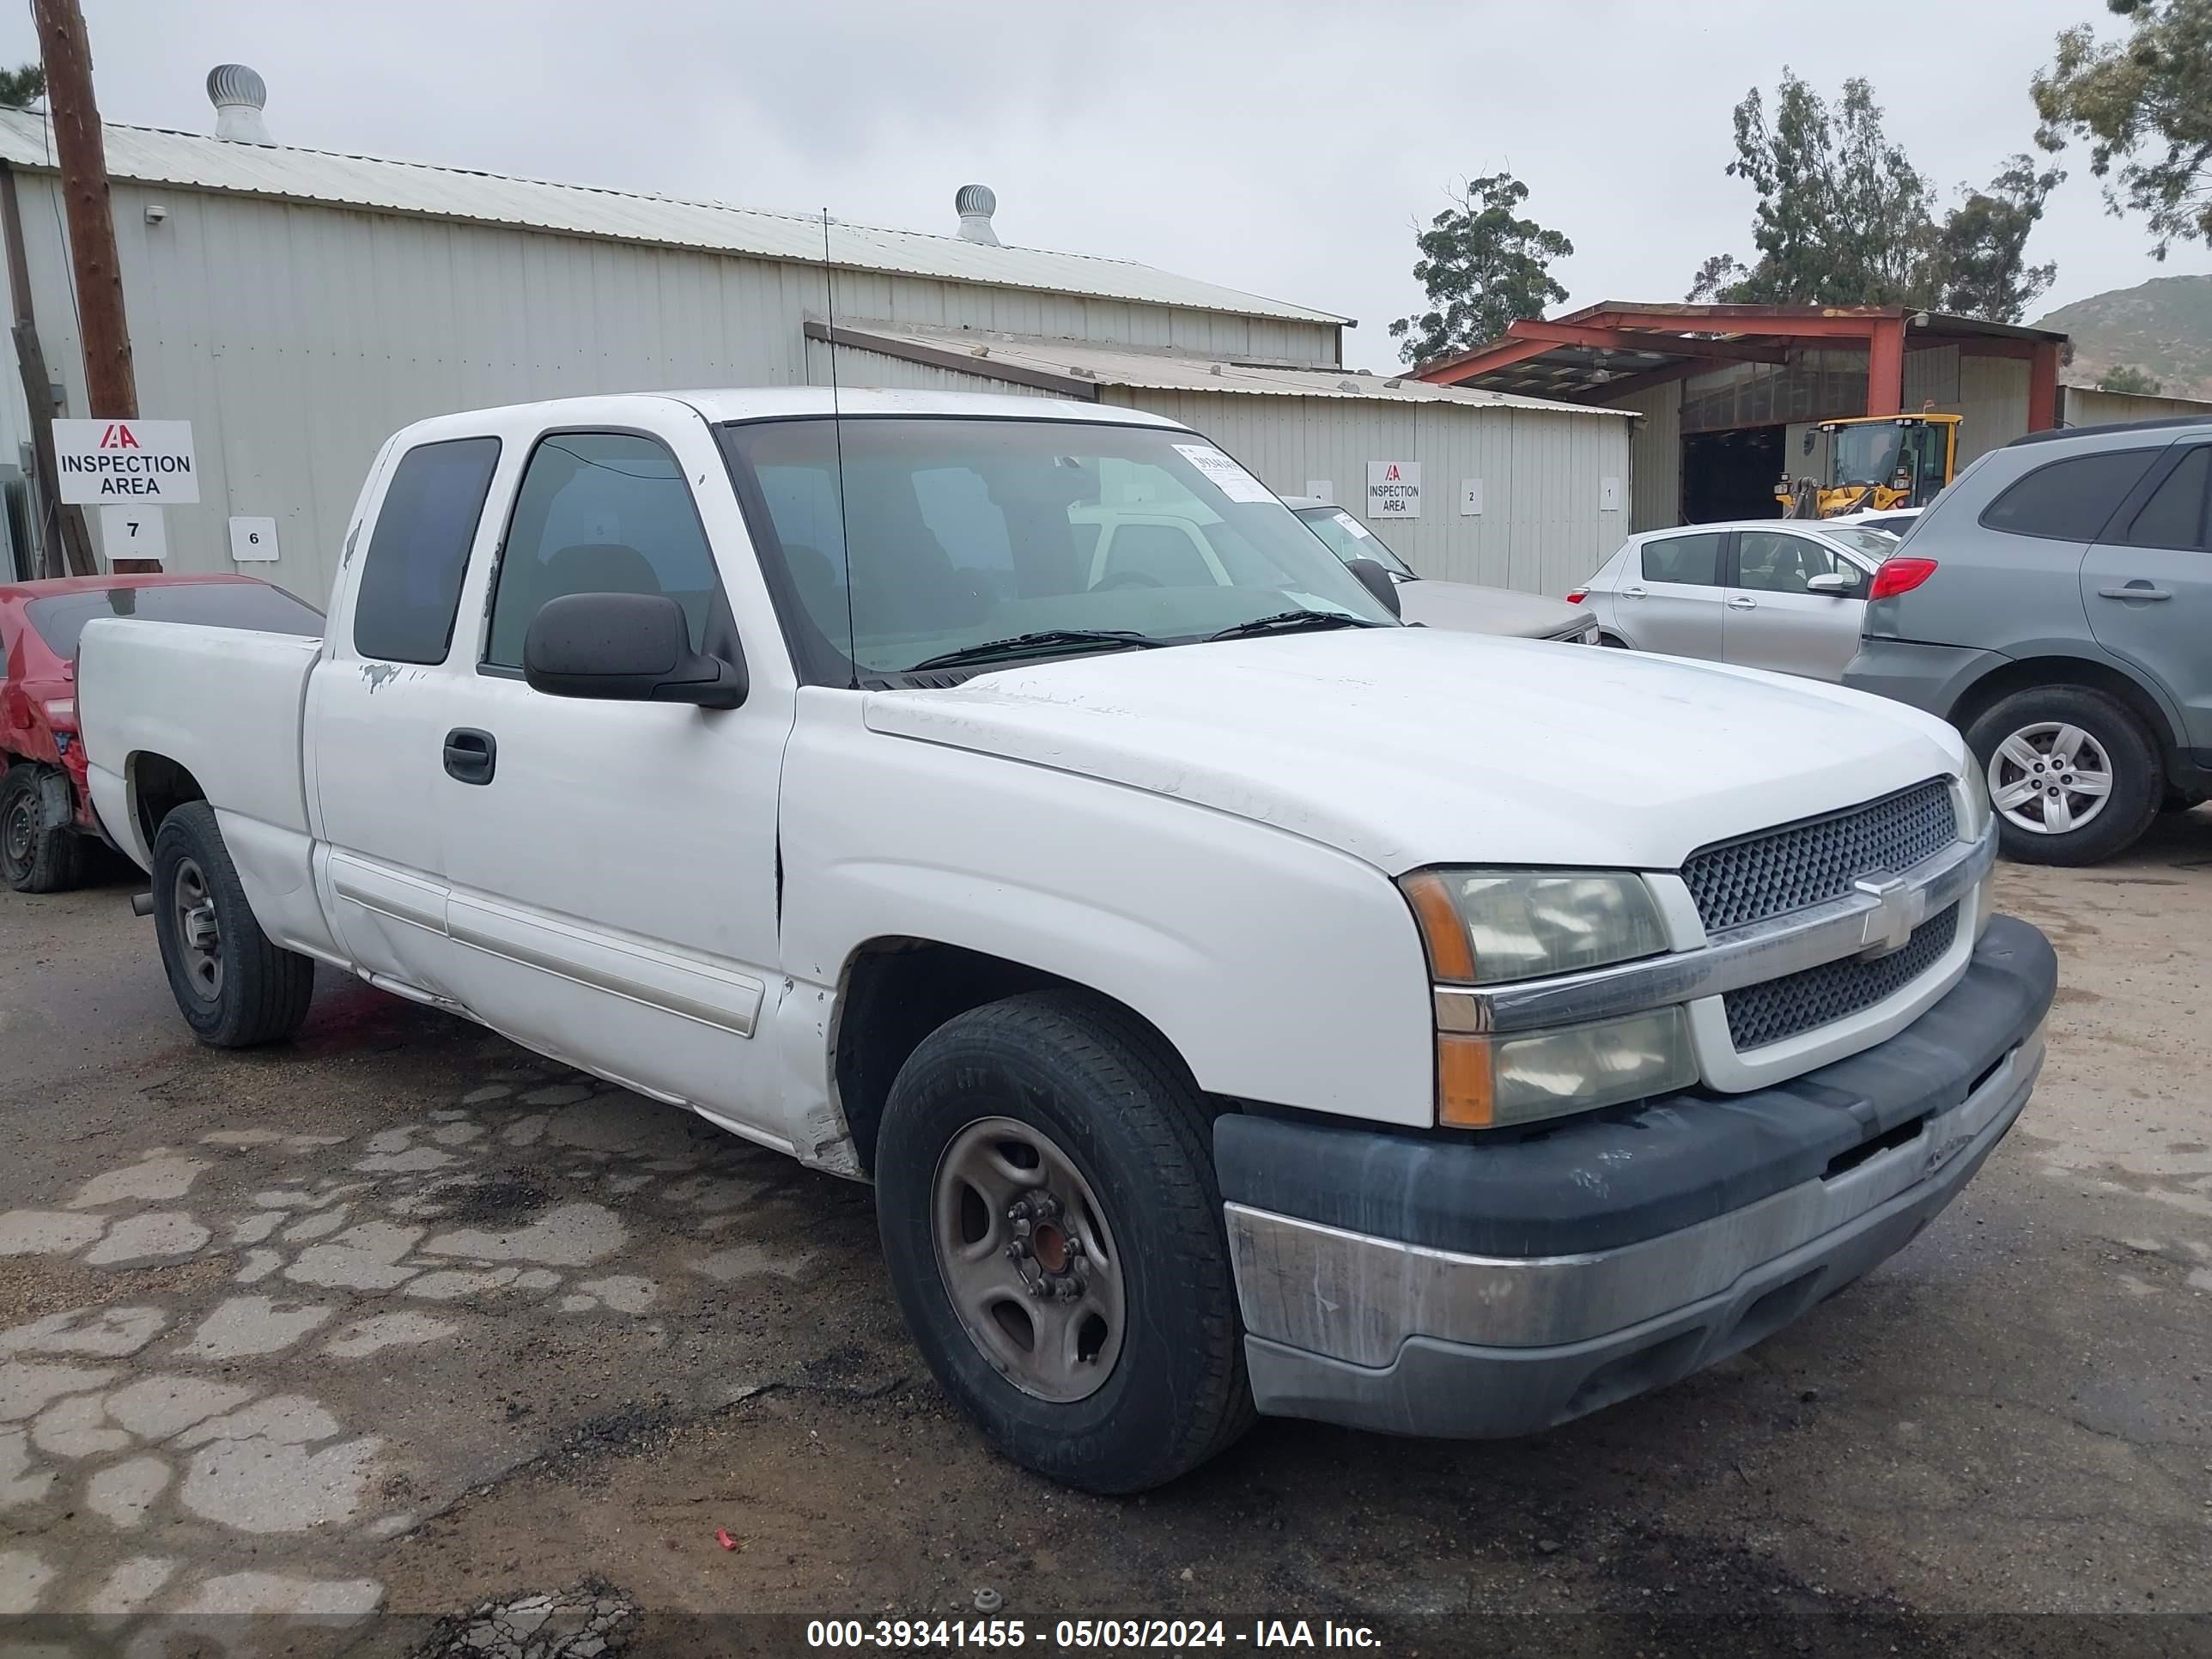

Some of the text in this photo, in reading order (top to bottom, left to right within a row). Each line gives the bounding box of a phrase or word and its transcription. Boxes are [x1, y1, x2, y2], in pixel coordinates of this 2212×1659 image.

[62, 455, 191, 472] INSPECTION
[100, 477, 161, 495] AREA
[1370, 485, 1419, 497] INSPECTION
[1469, 492, 1474, 501] 2
[1607, 488, 1612, 498] 1
[1382, 500, 1406, 512] AREA
[127, 523, 139, 537] 7
[249, 532, 259, 544] 6
